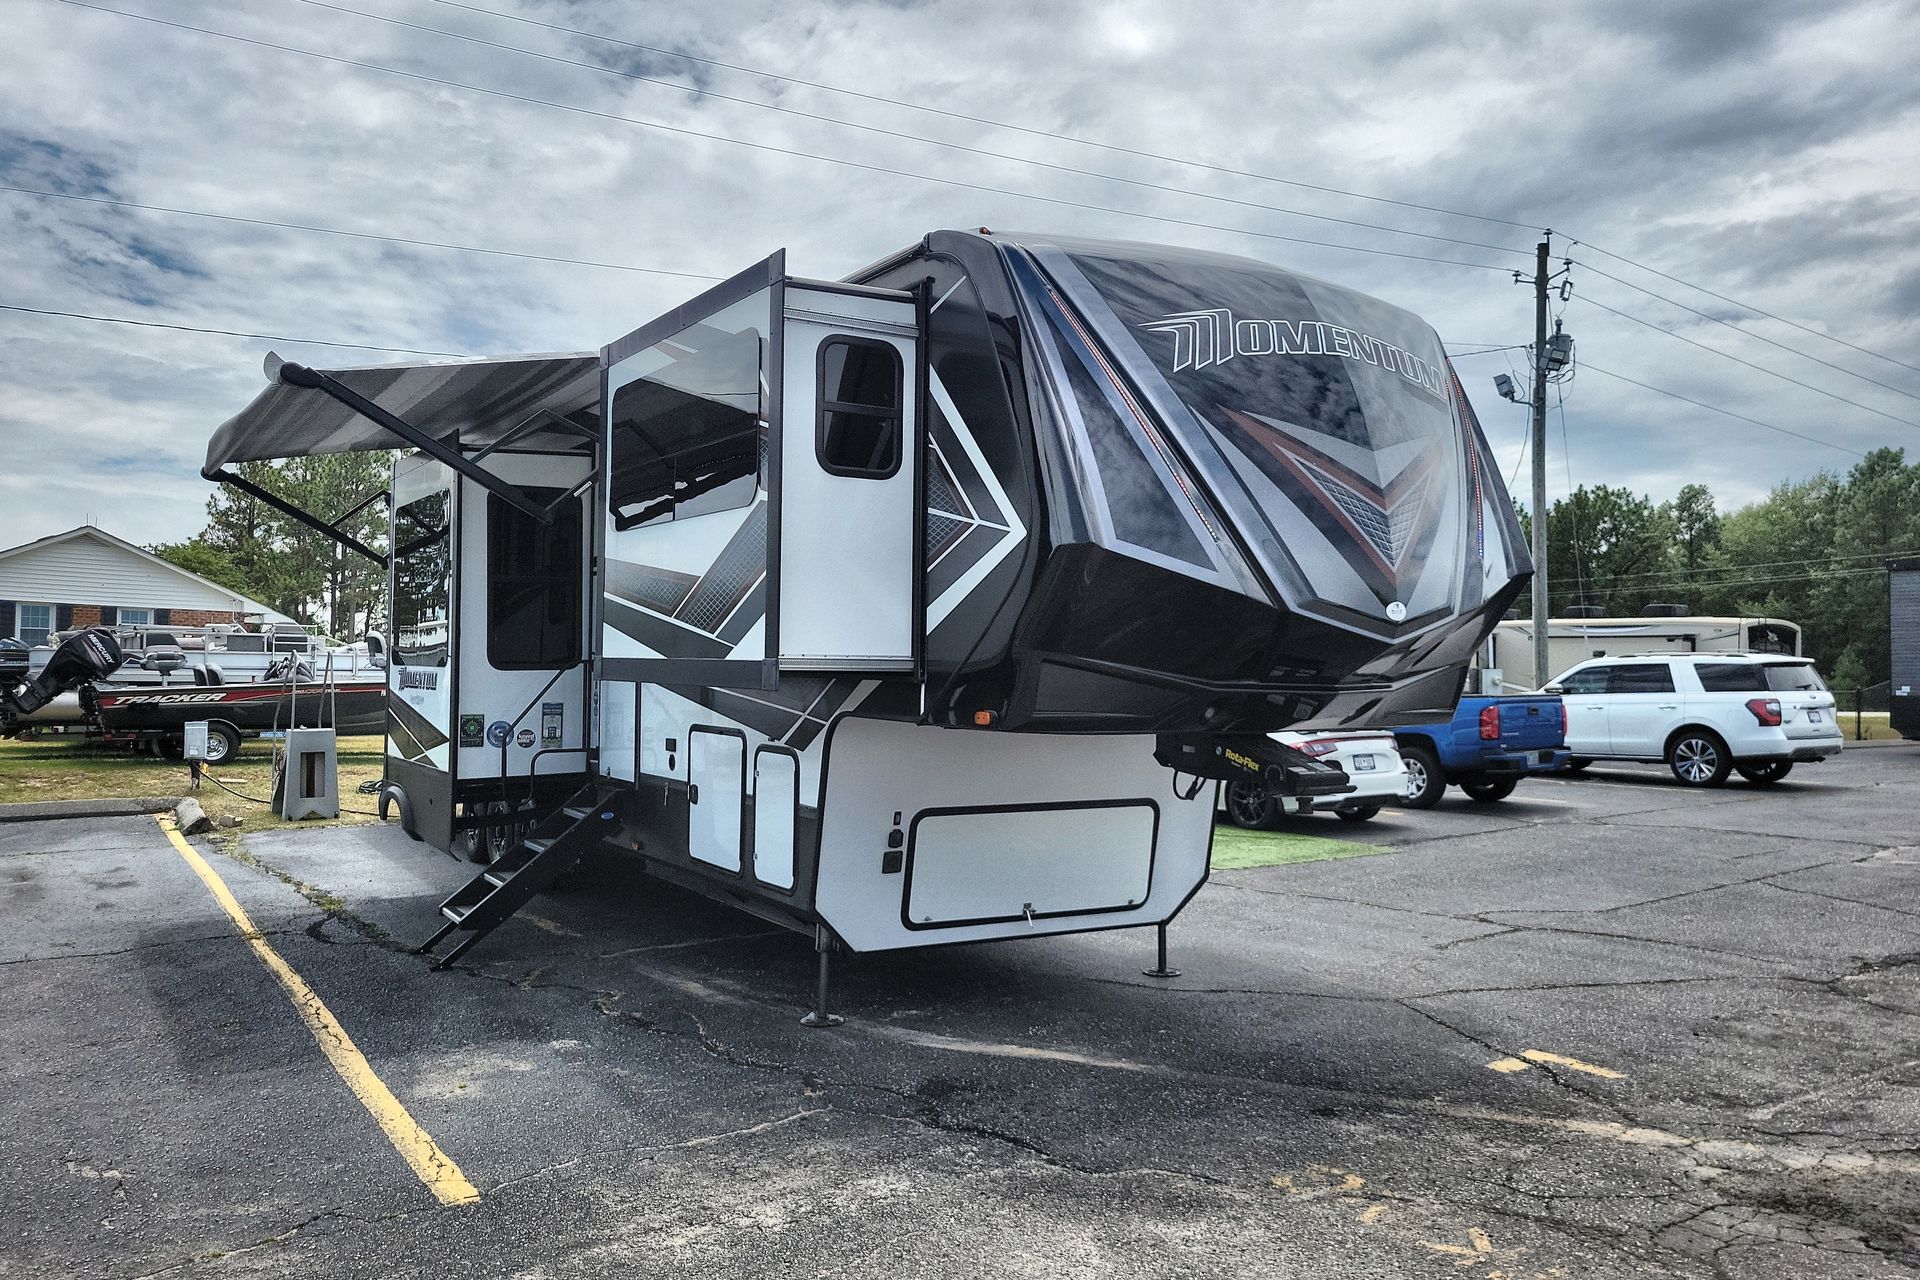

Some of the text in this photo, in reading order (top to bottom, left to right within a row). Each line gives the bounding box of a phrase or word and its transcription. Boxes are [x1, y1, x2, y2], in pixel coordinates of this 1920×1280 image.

[1137, 308, 1447, 400] MOMENTUM
[87, 633, 115, 664] MERCURY
[398, 667, 438, 690] MOMENTUM
[113, 692, 228, 705] TRACKER
[1225, 748, 1260, 773] Rota-Flex
